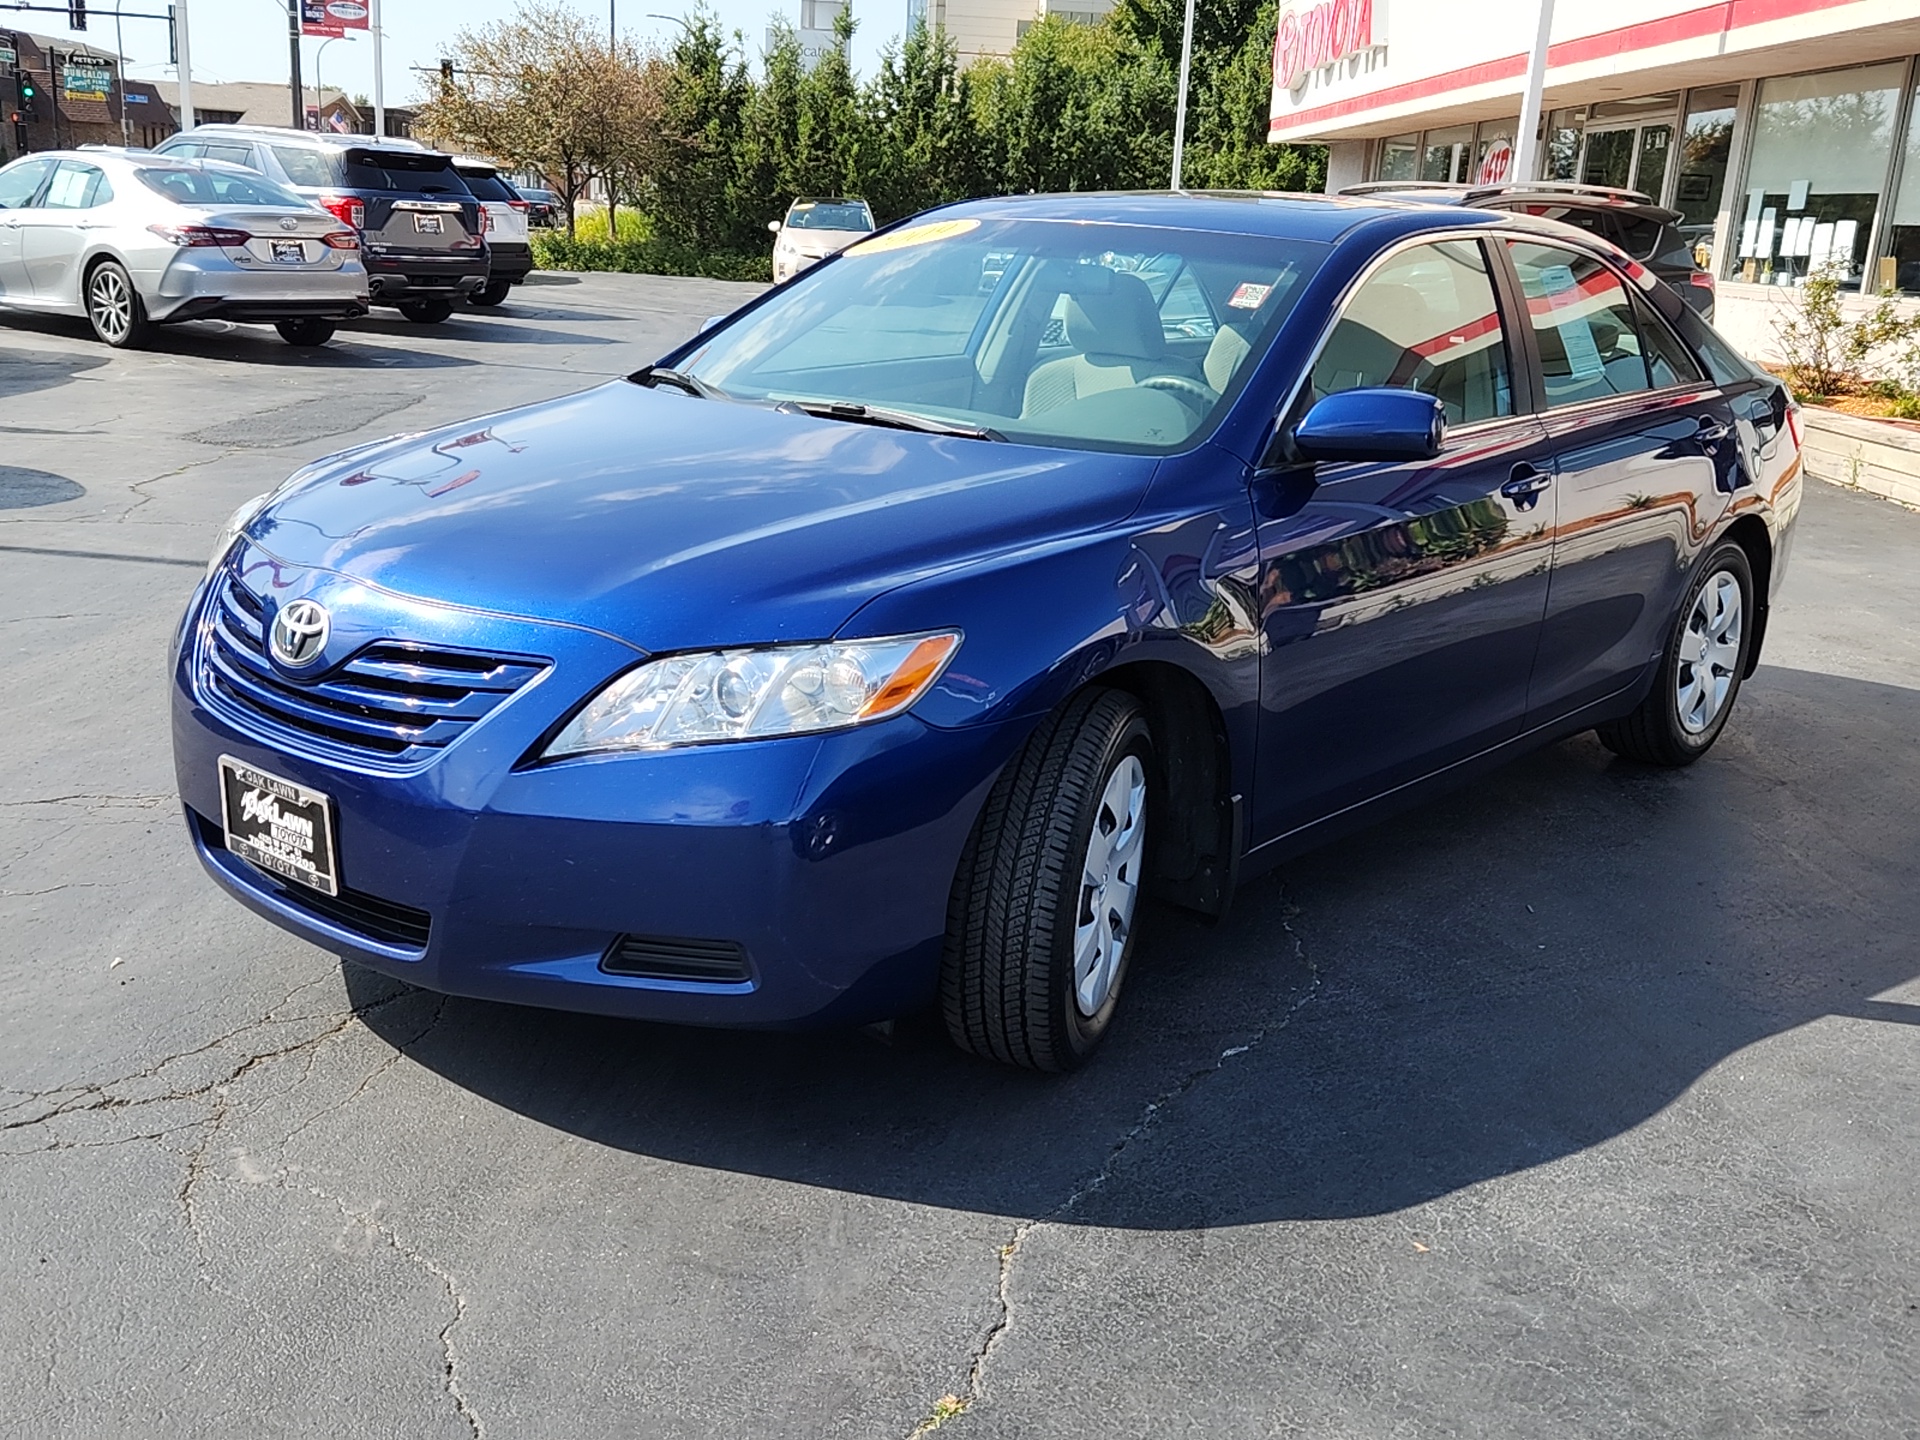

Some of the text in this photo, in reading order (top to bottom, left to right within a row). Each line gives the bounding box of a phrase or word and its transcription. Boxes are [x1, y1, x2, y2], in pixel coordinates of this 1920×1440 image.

[245, 771, 297, 800] OAK LAWN
[274, 825, 309, 850] TOYOTA
[257, 850, 298, 878] TOYOTA
